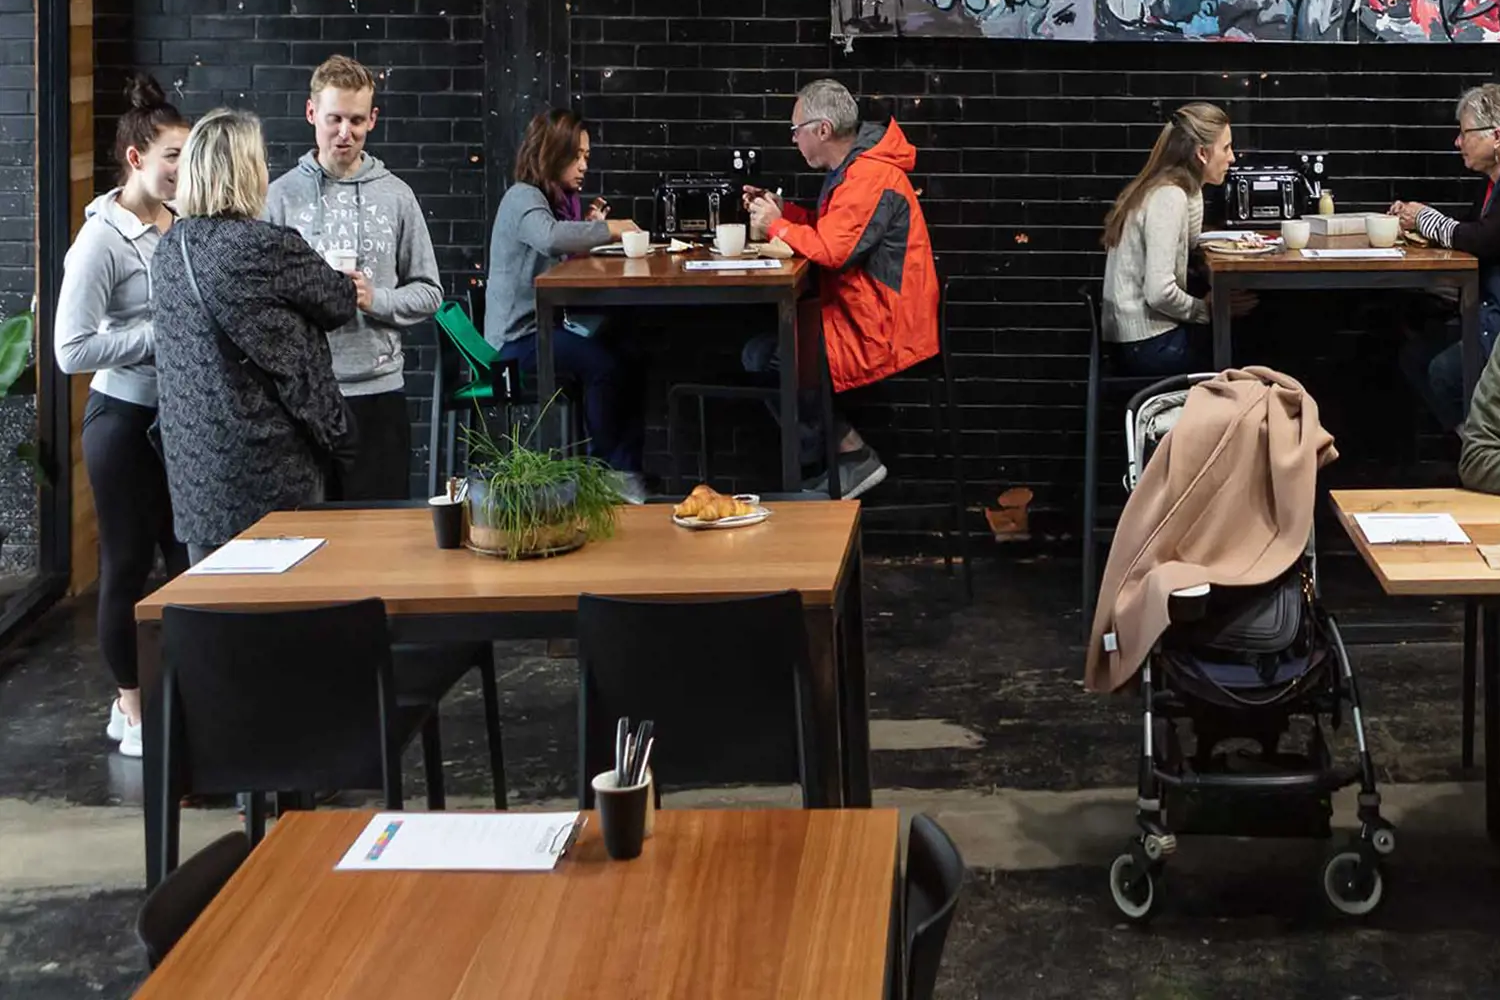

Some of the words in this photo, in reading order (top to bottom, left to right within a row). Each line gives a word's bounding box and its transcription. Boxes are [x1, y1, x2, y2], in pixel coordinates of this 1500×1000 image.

[337, 191, 393, 235] COAST
[323, 221, 371, 237] TATE
[315, 239, 392, 254] AMPIONS
[502, 366, 511, 398] 1
